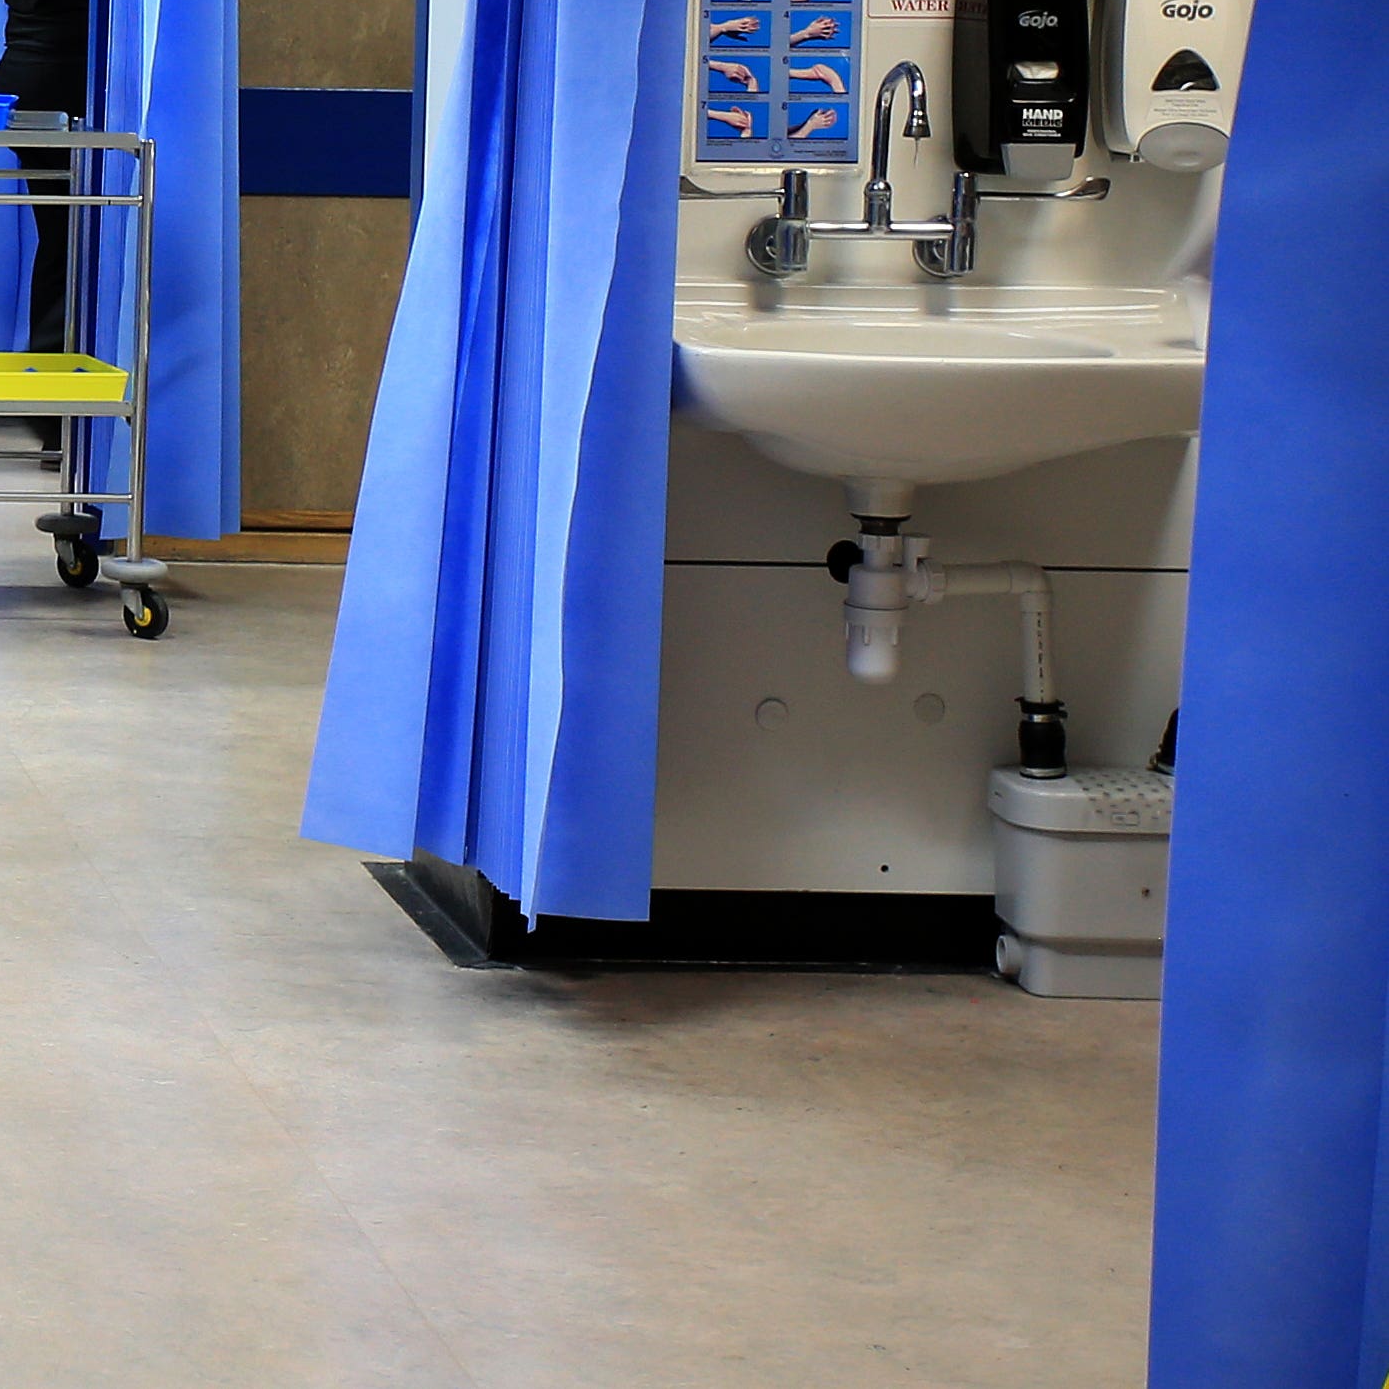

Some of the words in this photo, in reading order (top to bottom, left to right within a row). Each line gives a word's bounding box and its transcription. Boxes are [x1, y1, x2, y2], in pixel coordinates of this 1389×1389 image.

[890, 0, 949, 12] WATER
[703, 11, 709, 19] 3
[783, 11, 789, 19] 4
[702, 55, 708, 64] 5
[782, 56, 789, 64] 6
[701, 101, 707, 109] 7
[782, 101, 788, 110] 8
[1022, 108, 1064, 120] HAND
